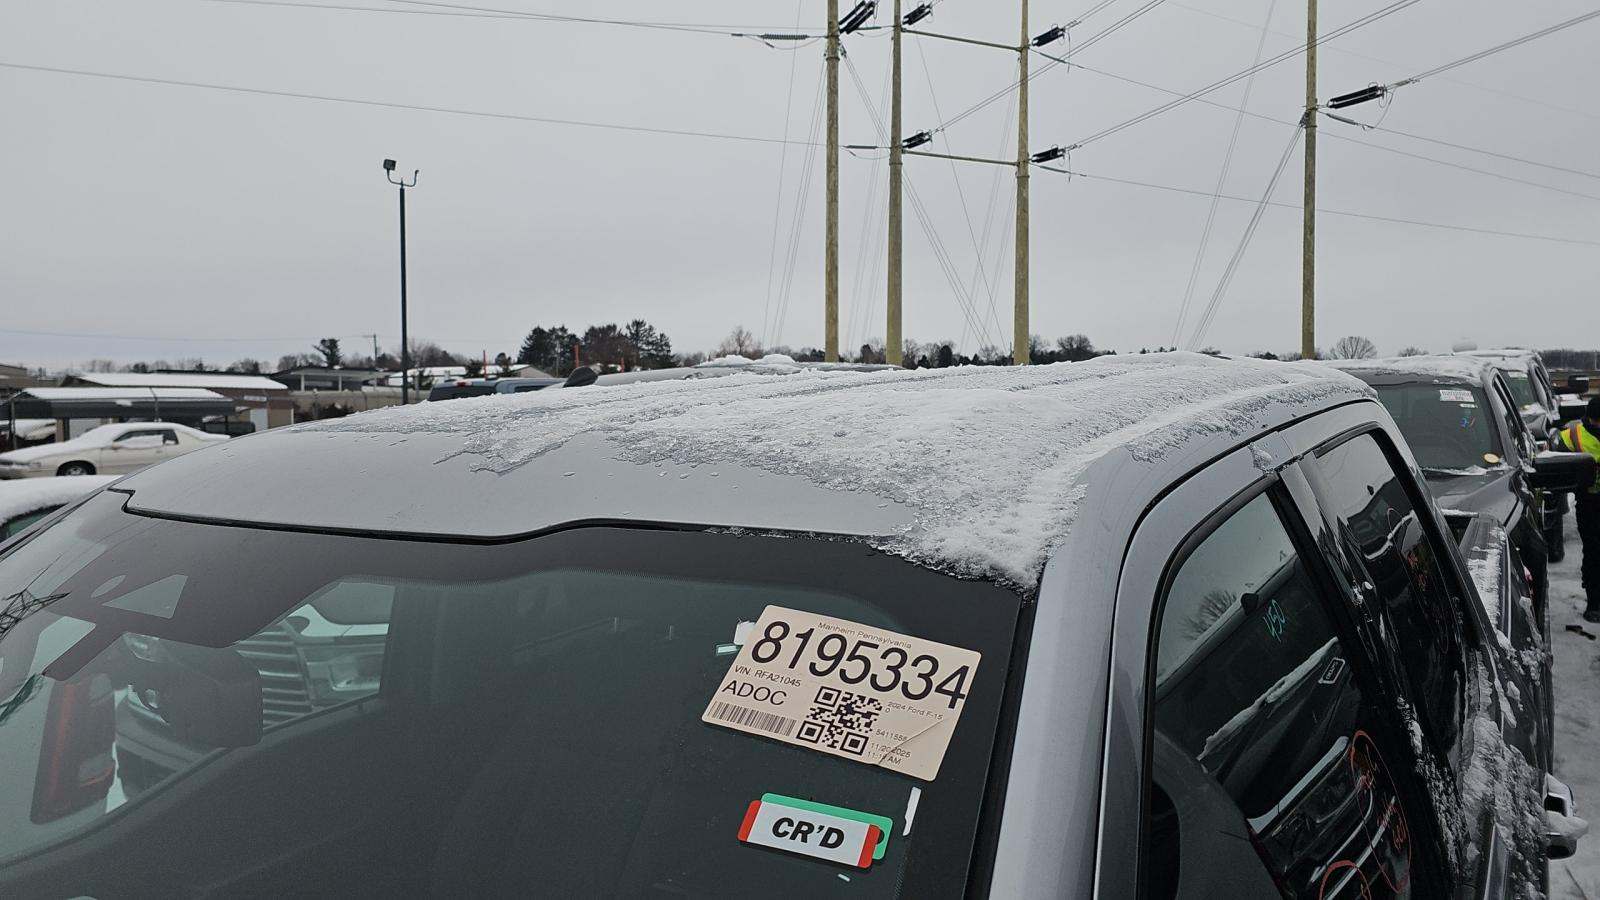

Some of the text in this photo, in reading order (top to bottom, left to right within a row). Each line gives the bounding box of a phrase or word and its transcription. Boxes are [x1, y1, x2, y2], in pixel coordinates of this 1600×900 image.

[817, 622, 912, 650] Manheim Pennsylvania
[751, 620, 970, 709] 8195334
[754, 669, 802, 687] RFA21045
[721, 680, 787, 706] ADOC
[887, 701, 944, 720] 2024 Ford F-15
[887, 756, 902, 766] AM
[772, 817, 845, 849] CR'D
